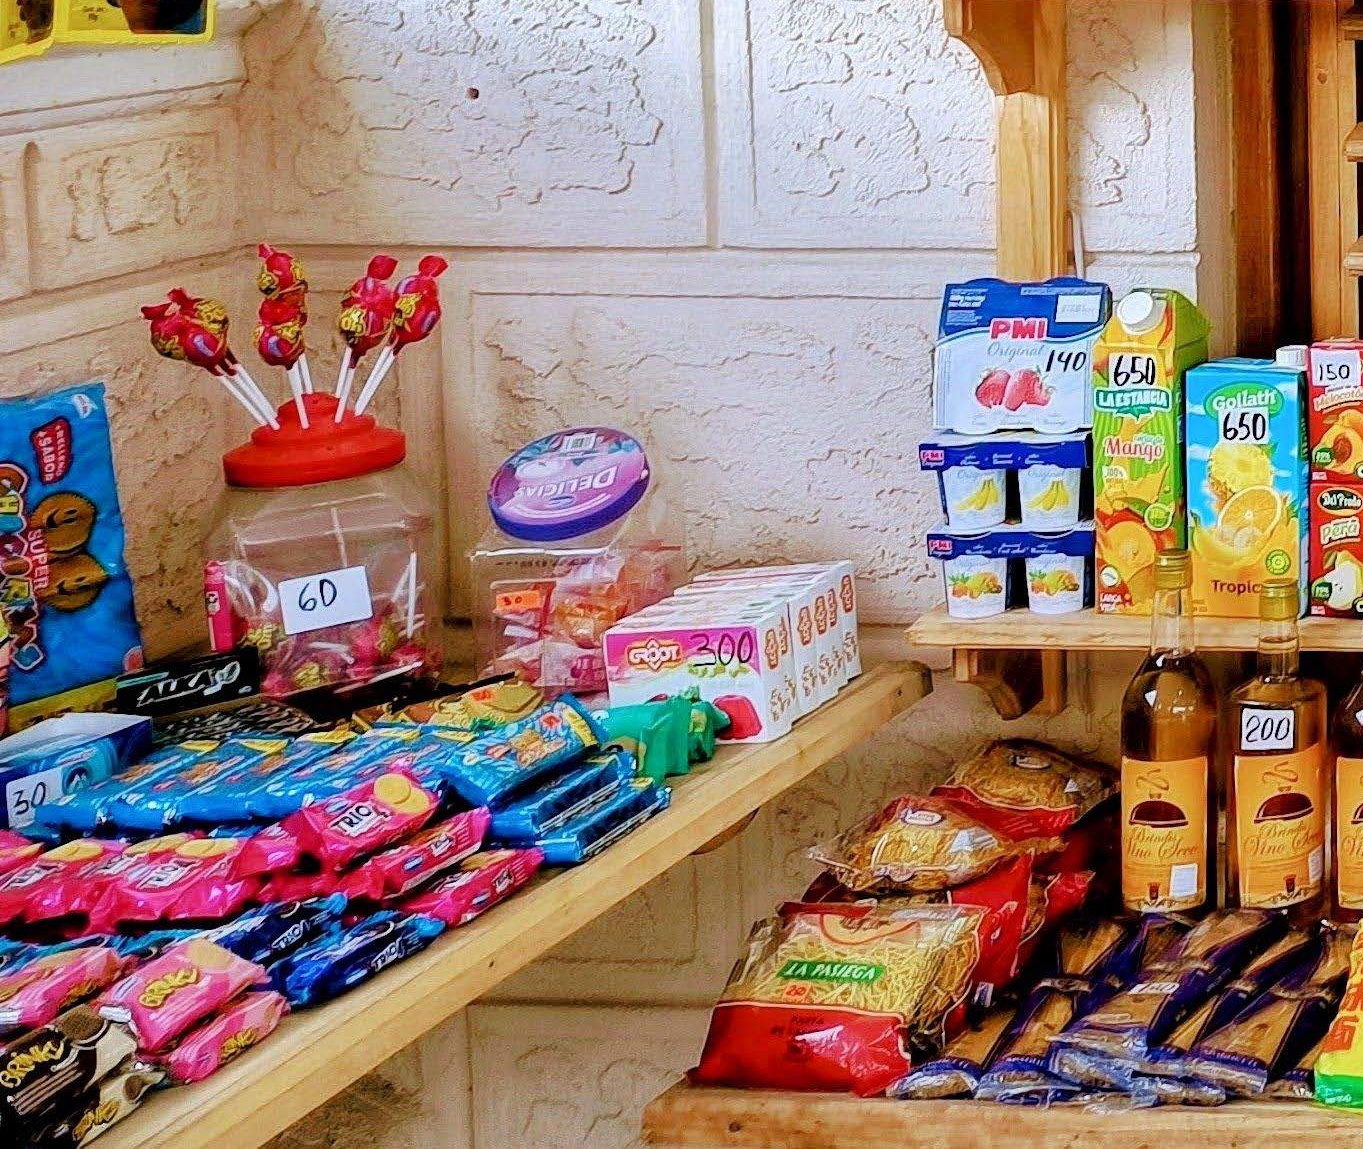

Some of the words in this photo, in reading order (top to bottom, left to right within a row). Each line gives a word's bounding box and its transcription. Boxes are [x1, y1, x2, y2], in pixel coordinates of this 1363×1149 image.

[989, 318, 1048, 339] PMI
[987, 344, 1044, 358] Original
[1046, 350, 1087, 372] 140
[1113, 355, 1156, 386] 650
[1317, 364, 1351, 381] 150
[1212, 393, 1277, 411] Goliath
[1222, 413, 1266, 441] 650
[1104, 438, 1164, 461] Mango
[28, 530, 49, 590] SUPER
[299, 578, 338, 612] 60
[688, 630, 753, 667] 300
[1246, 716, 1290, 743] 200
[784, 963, 807, 977] LA
[811, 964, 875, 980] PASIEGA
